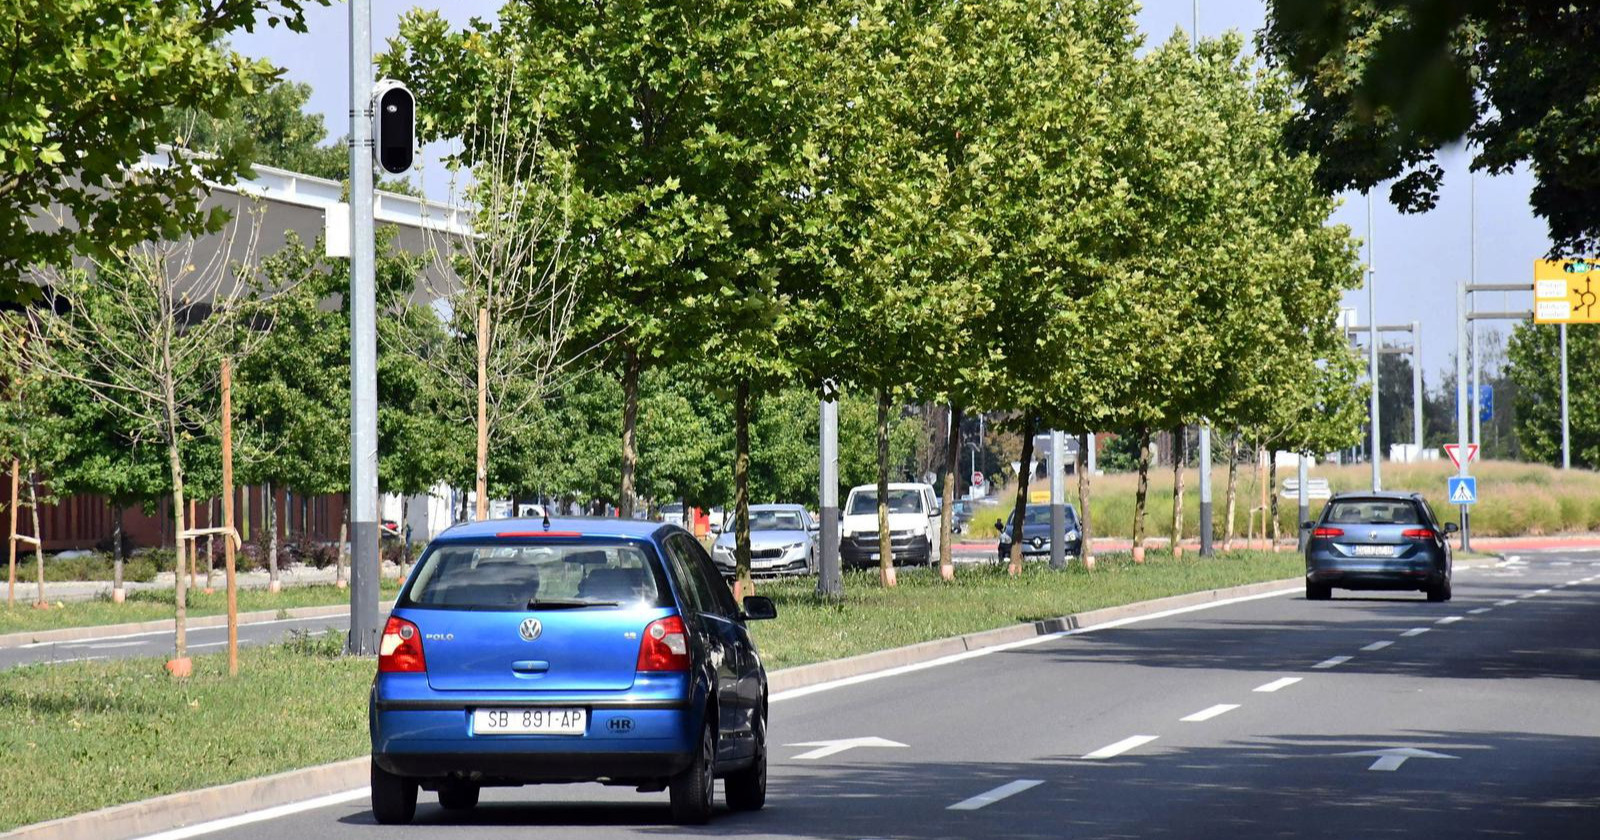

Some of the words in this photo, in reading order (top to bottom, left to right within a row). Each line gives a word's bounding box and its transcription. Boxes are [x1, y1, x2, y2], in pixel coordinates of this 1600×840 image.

[425, 633, 454, 641] POLO
[488, 710, 509, 728] SB
[522, 710, 582, 728] 891-AP
[610, 719, 632, 729] HR
